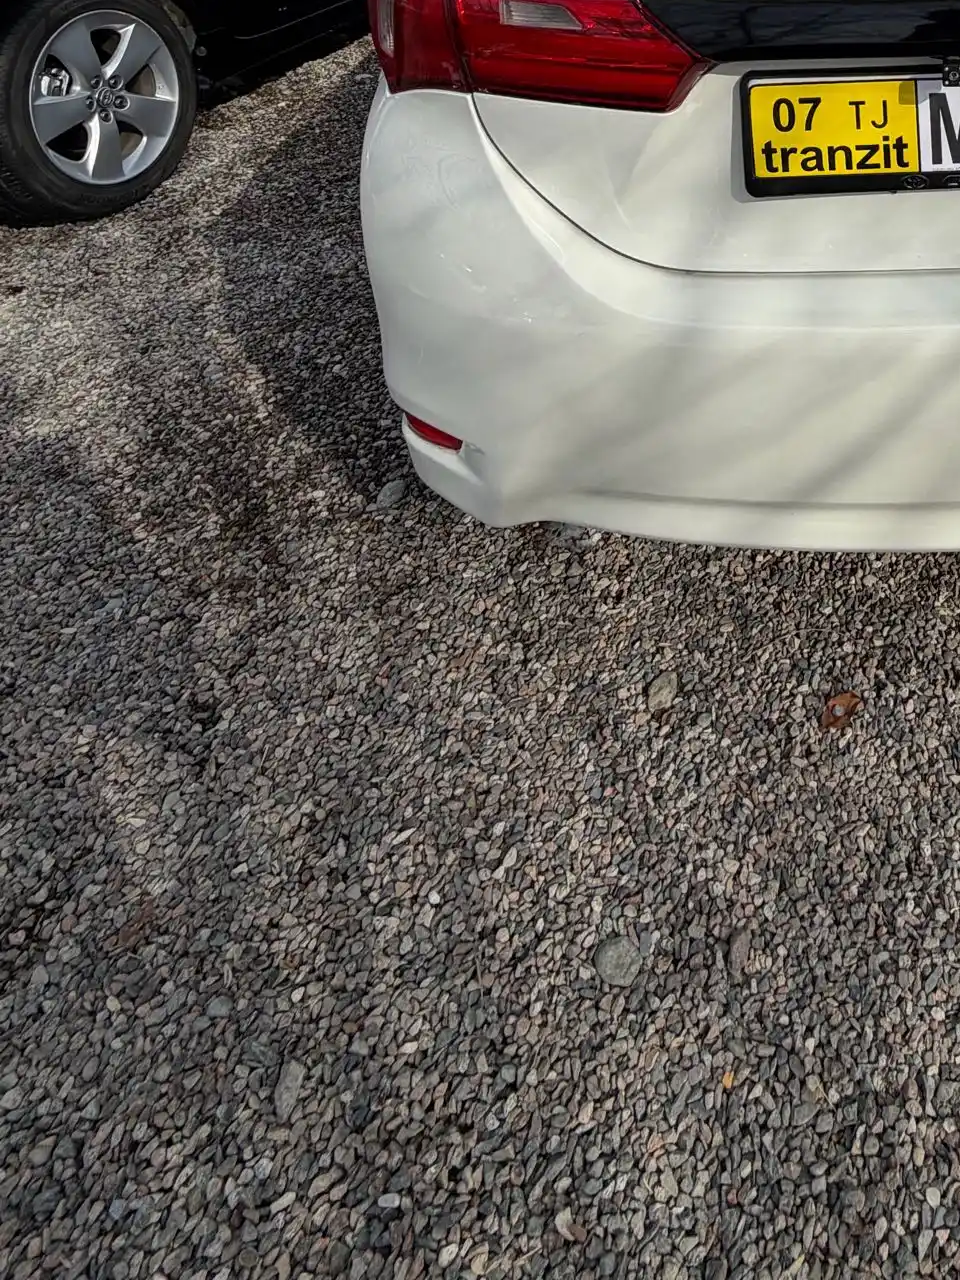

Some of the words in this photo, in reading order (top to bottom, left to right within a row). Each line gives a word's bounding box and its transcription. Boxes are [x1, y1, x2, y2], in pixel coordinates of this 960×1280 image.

[772, 97, 822, 133] 07
[848, 99, 888, 130] TJ
[761, 135, 910, 173] tranzit
